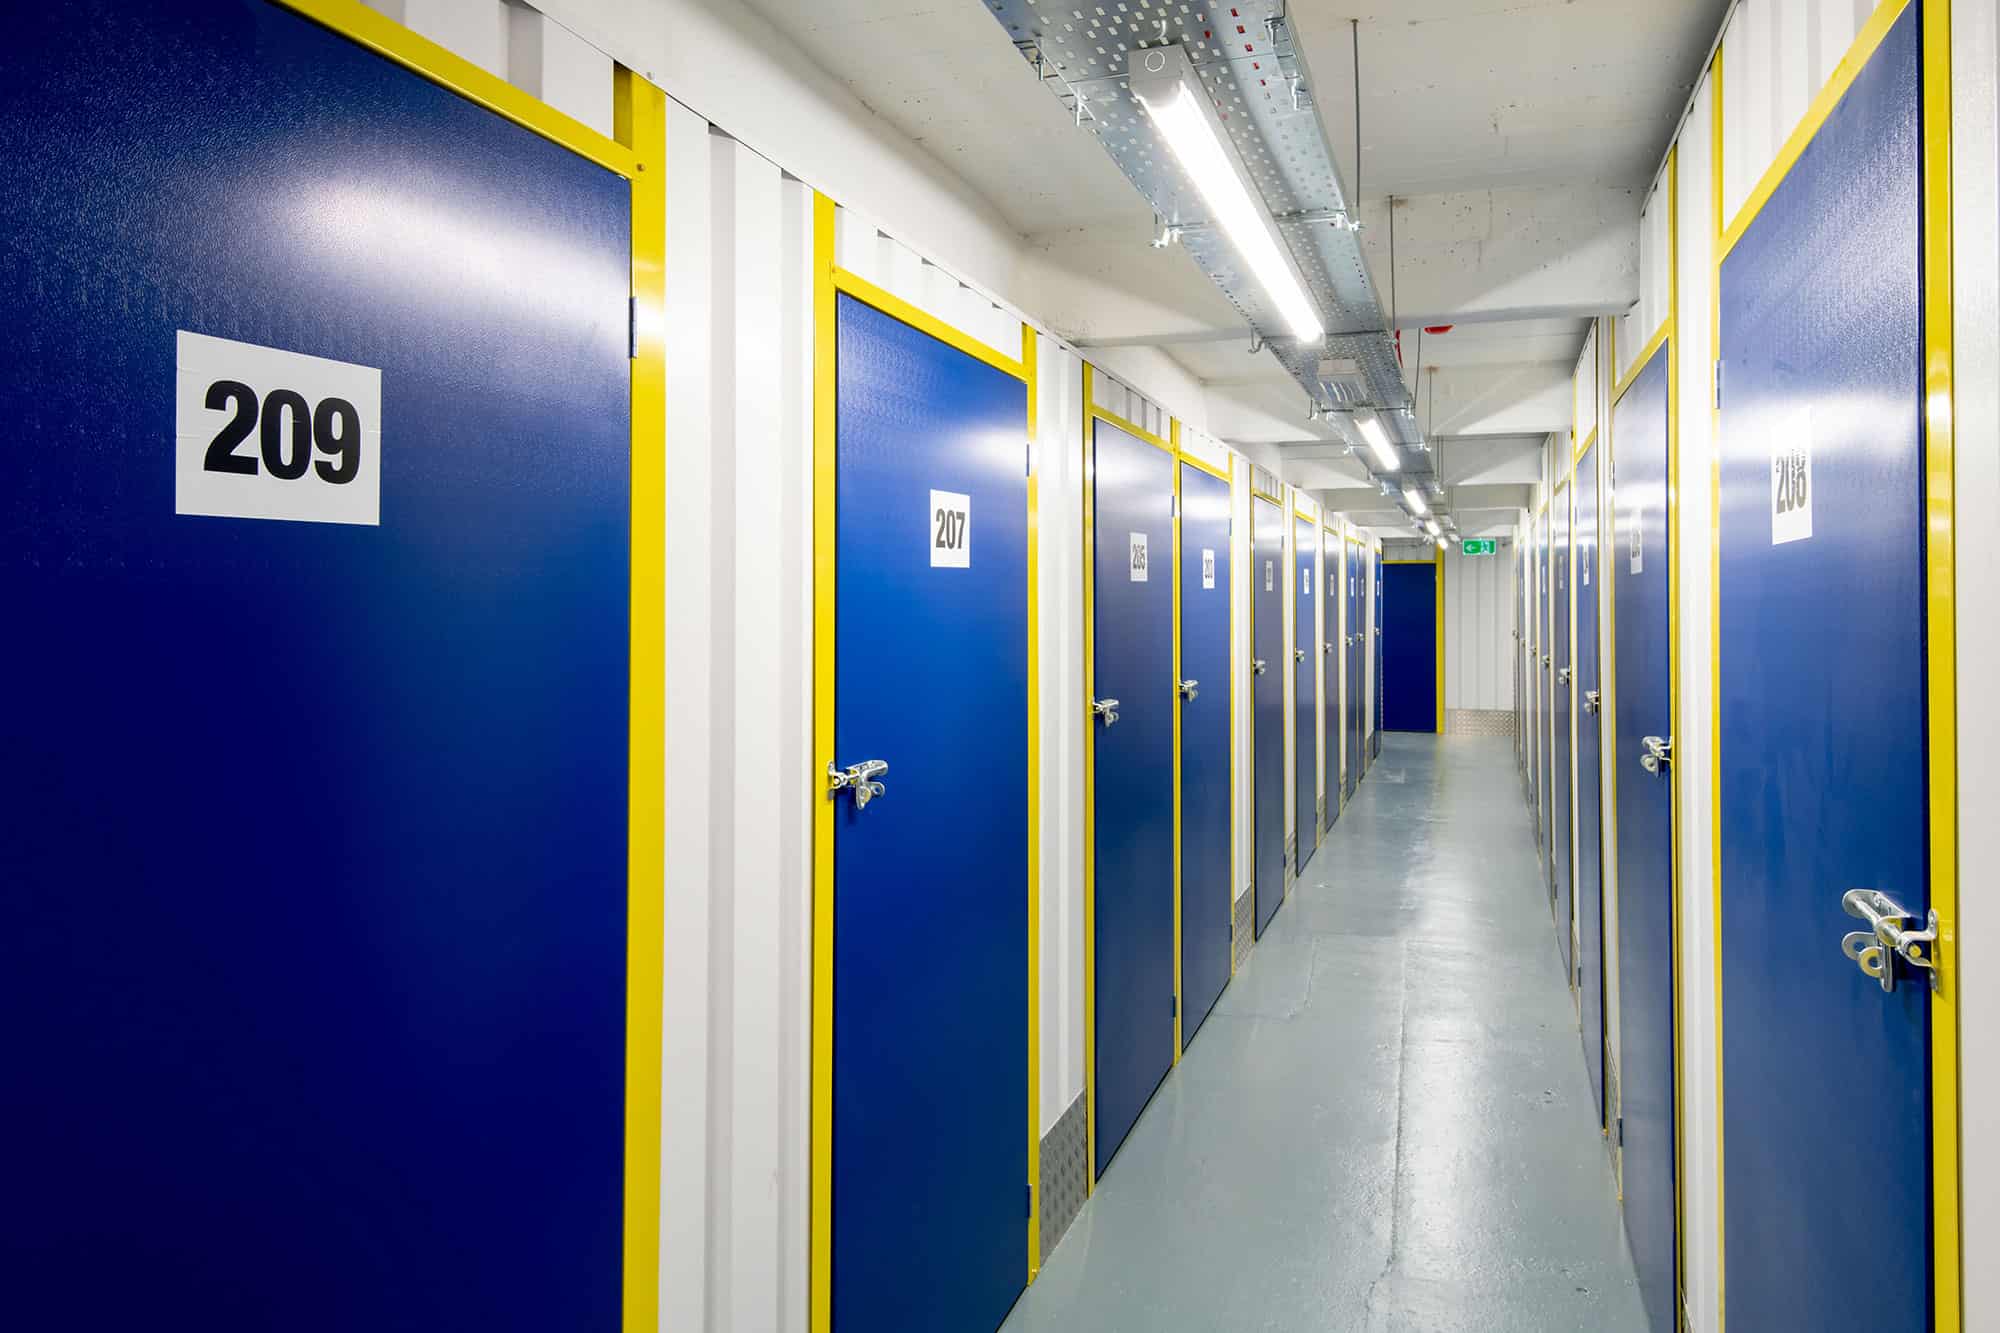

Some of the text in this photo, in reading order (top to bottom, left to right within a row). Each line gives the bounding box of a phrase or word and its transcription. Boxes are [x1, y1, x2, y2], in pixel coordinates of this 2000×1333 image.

[203, 379, 361, 485] 209
[1775, 450, 1807, 514] 208
[935, 508, 966, 550] 207
